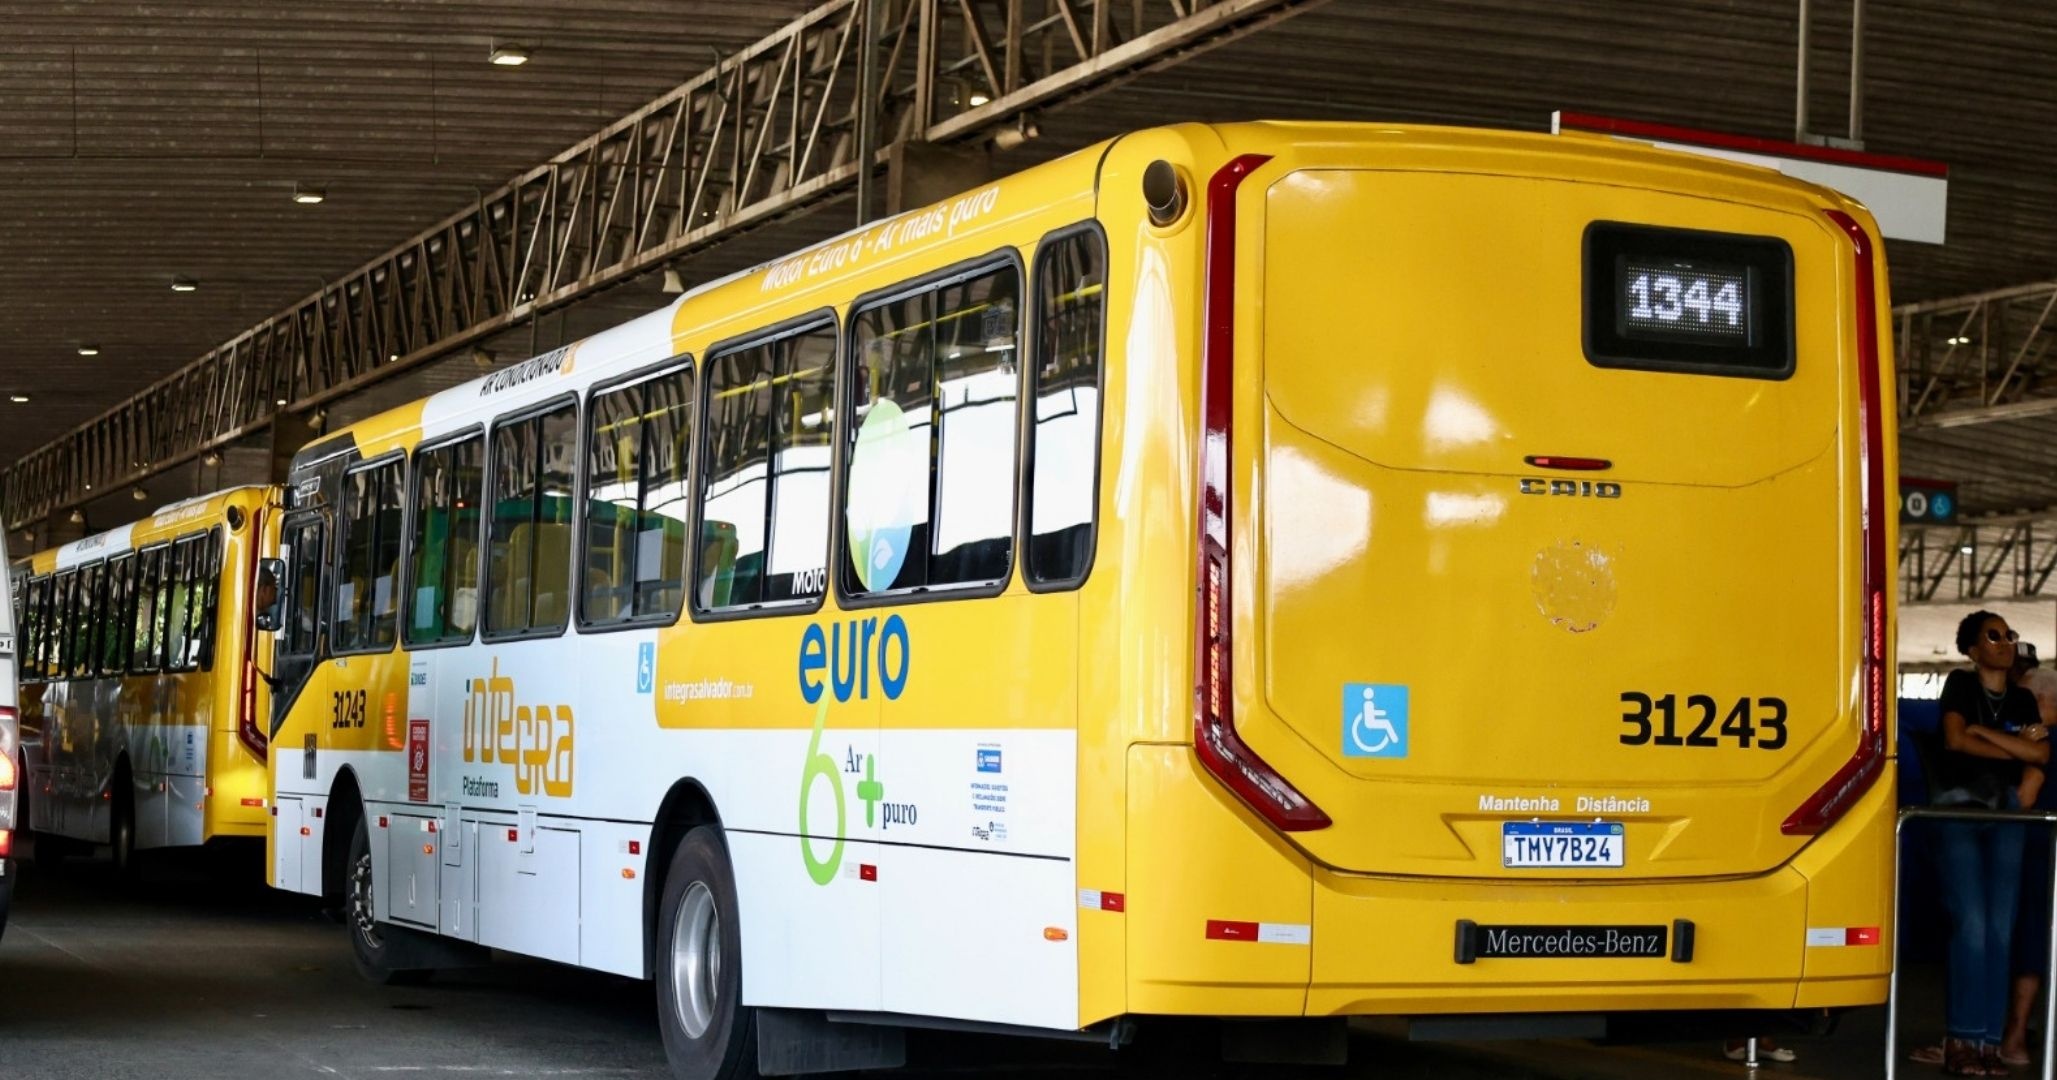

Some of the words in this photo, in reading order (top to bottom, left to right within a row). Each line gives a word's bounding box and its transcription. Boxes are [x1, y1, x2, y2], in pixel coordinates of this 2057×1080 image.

[761, 257, 809, 292] Motor
[808, 243, 849, 277] Euro
[851, 233, 868, 262] 6
[873, 222, 903, 254] Ar
[900, 203, 948, 244] mais
[948, 187, 999, 238] puro
[1631, 275, 1741, 325] 1344
[1520, 478, 1621, 498] CAIO
[799, 614, 909, 704] euro
[333, 689, 366, 728] 31243
[1620, 691, 1788, 750] 31243
[845, 744, 862, 773] Ar
[463, 776, 498, 798] Plataforma
[799, 664, 846, 886] 6
[882, 802, 917, 830] puro
[1478, 795, 1559, 812] Mantenha
[1576, 796, 1650, 813] Distância
[1515, 837, 1611, 863] TMY7B24
[1486, 928, 1659, 954] Mercedes-Benz
